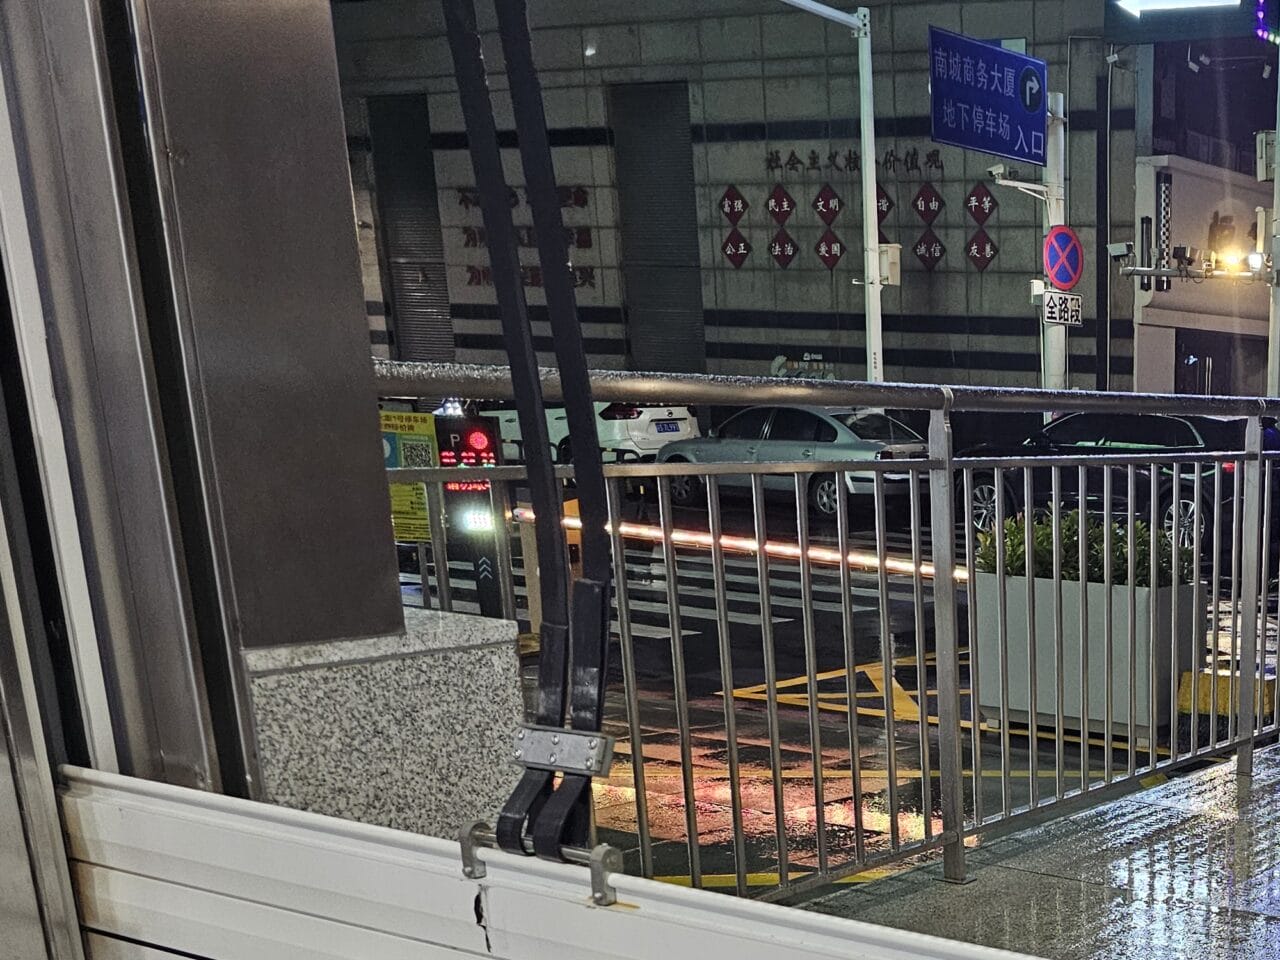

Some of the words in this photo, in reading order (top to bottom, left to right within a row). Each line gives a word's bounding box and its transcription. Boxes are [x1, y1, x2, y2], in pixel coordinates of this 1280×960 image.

[934, 48, 1016, 98] 南城商务大厦
[942, 99, 1044, 157] 地下停车场入口
[766, 149, 945, 173] 社会主义核价值观
[722, 198, 744, 213] 富强
[768, 197, 790, 212] 民主
[816, 197, 839, 212] 文明
[917, 196, 939, 212] 自由
[967, 196, 992, 213] 平等
[725, 243, 748, 255] 公正
[771, 242, 794, 256] 法治
[819, 243, 841, 256] 爱国
[917, 242, 941, 257] 诚信
[969, 242, 994, 258] 友善
[1046, 295, 1081, 323] 全路段
[450, 434, 460, 447] P
